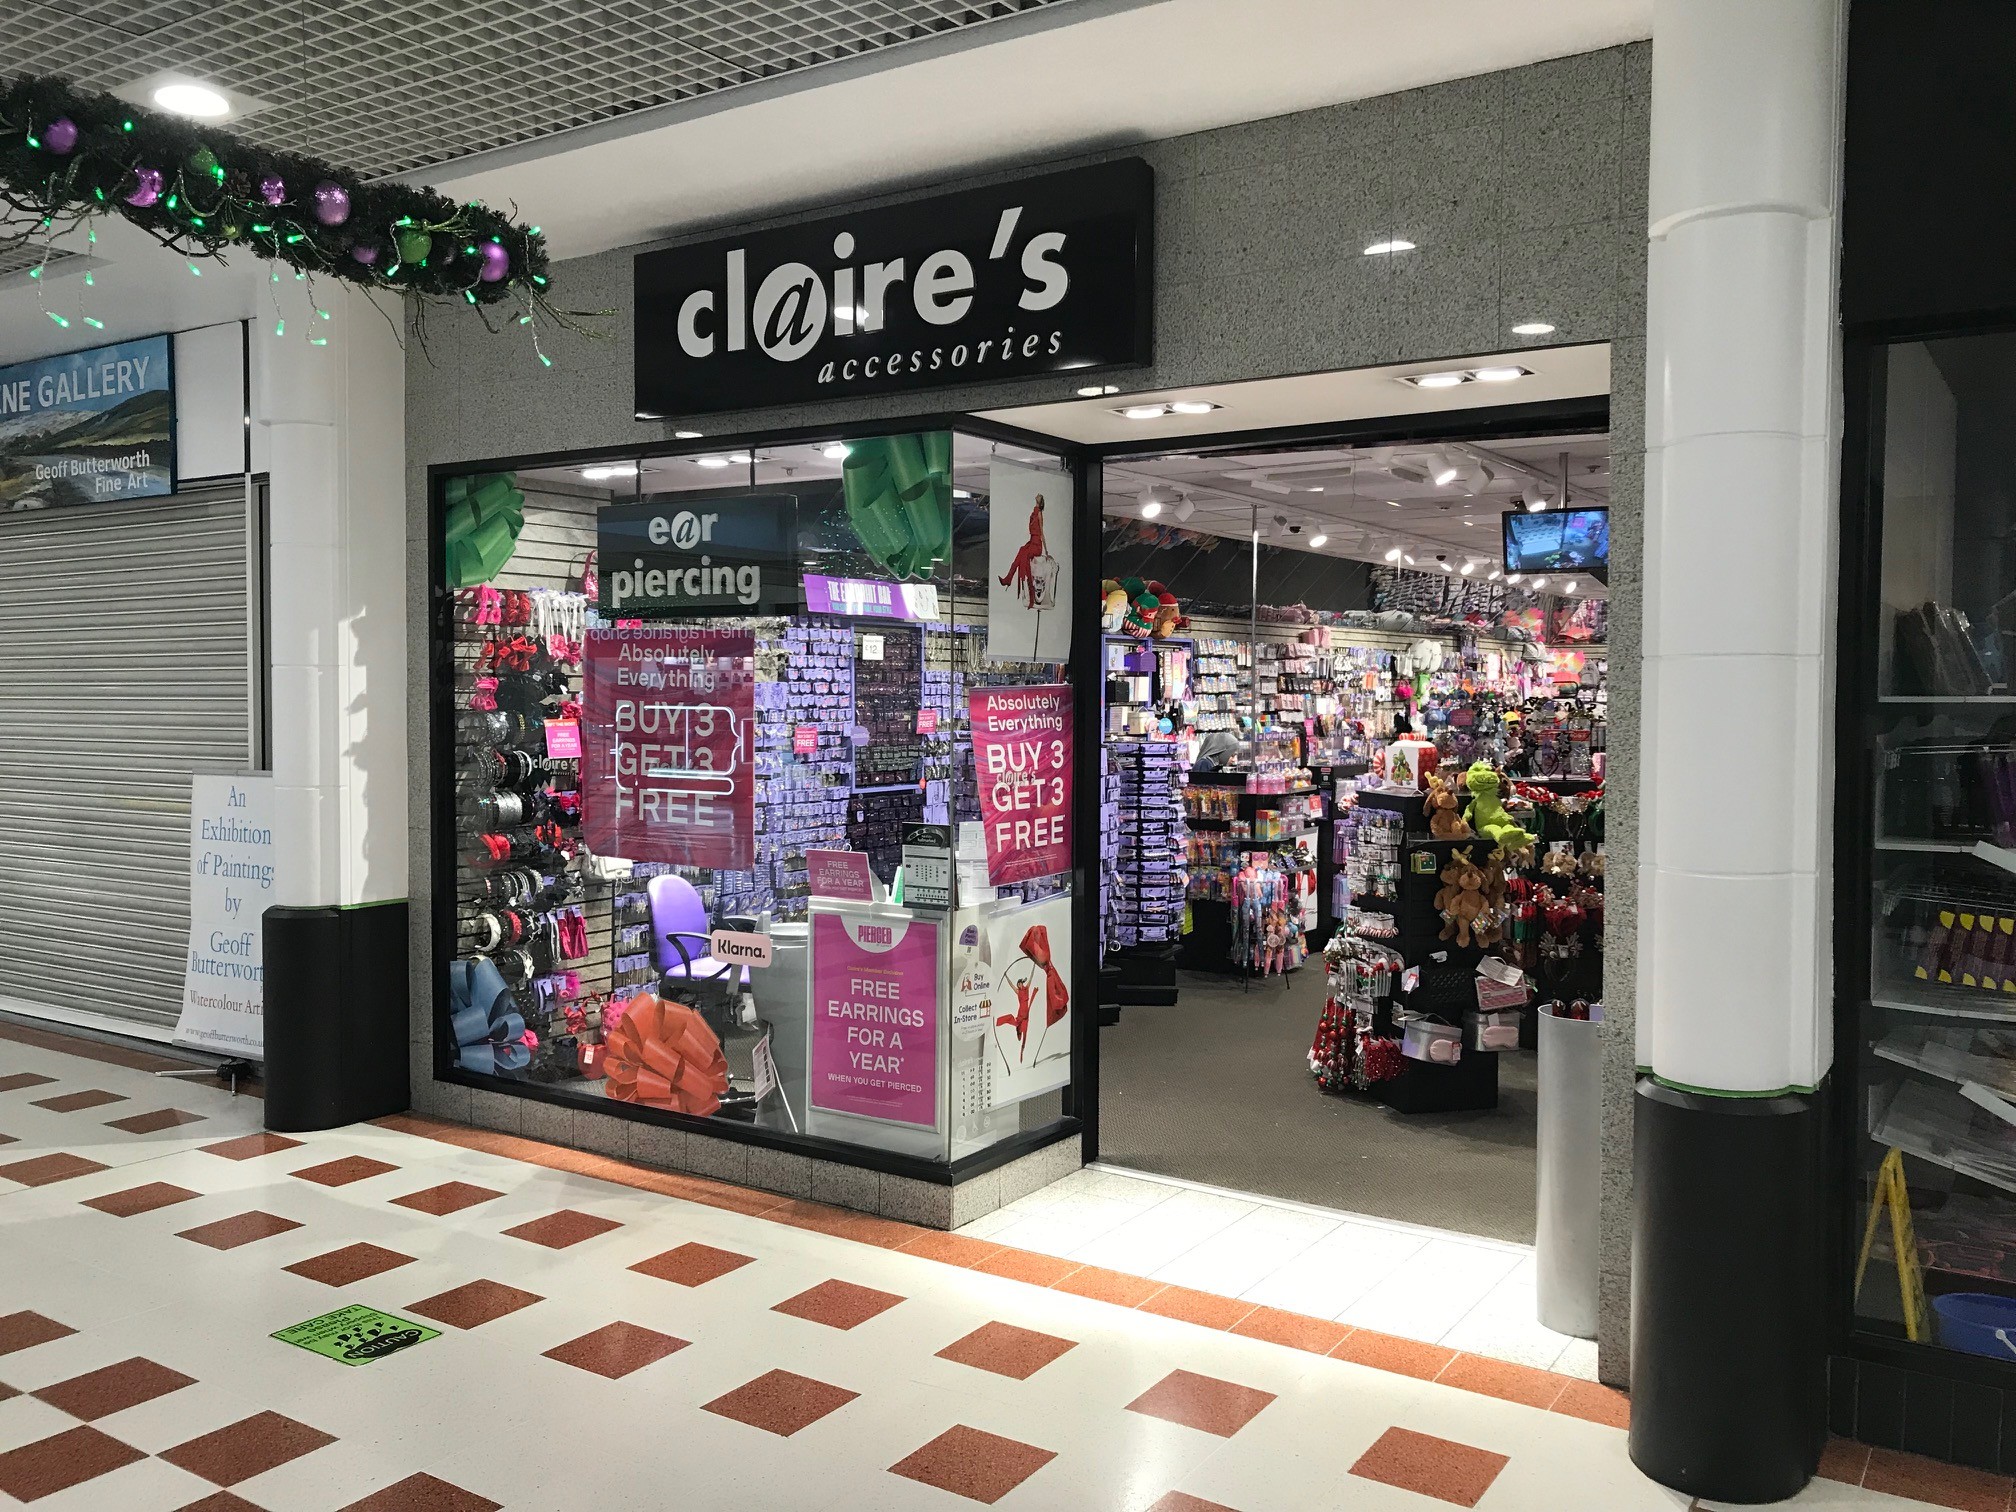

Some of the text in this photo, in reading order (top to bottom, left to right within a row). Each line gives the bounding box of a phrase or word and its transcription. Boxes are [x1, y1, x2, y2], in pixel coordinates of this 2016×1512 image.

[818, 327, 1062, 384] accessories
[0, 356, 149, 414] NE GALLERY
[36, 450, 150, 480] Geoff Butterworth
[96, 472, 148, 493] Fine Art
[612, 555, 761, 608] piercing
[619, 643, 714, 662] Absolutely
[617, 667, 714, 693] Everything
[987, 694, 1060, 711] Absolutely
[616, 700, 714, 736] BUY 3
[988, 714, 1063, 732] Everything
[797, 739, 814, 747] FREE
[618, 743, 685, 776] GET
[695, 747, 714, 780] 3
[986, 740, 1064, 774] BUY 3
[228, 786, 246, 807] An
[992, 777, 1064, 812] GET 3
[202, 816, 271, 844] Exhibition
[197, 852, 211, 874] of
[819, 868, 860, 879] EARRINGS
[827, 861, 848, 869] FREE
[817, 877, 864, 887] FOR A YEAR
[225, 887, 242, 919] by
[211, 931, 254, 956] Geoff
[858, 925, 892, 945] PIERCED
[718, 939, 766, 958] Klarna.
[192, 951, 263, 981] Butterwort
[973, 982, 990, 991] Online
[974, 973, 984, 981] Buy
[851, 979, 900, 1000] FREE
[828, 1000, 925, 1027] EARRINGS
[954, 1014, 977, 1024] In-Store
[958, 1004, 977, 1014] Collect
[847, 1026, 903, 1050] FOR A
[827, 1073, 922, 1093] WHEN YOU GET PIERCED
[347, 1330, 421, 1358] CAUTION
